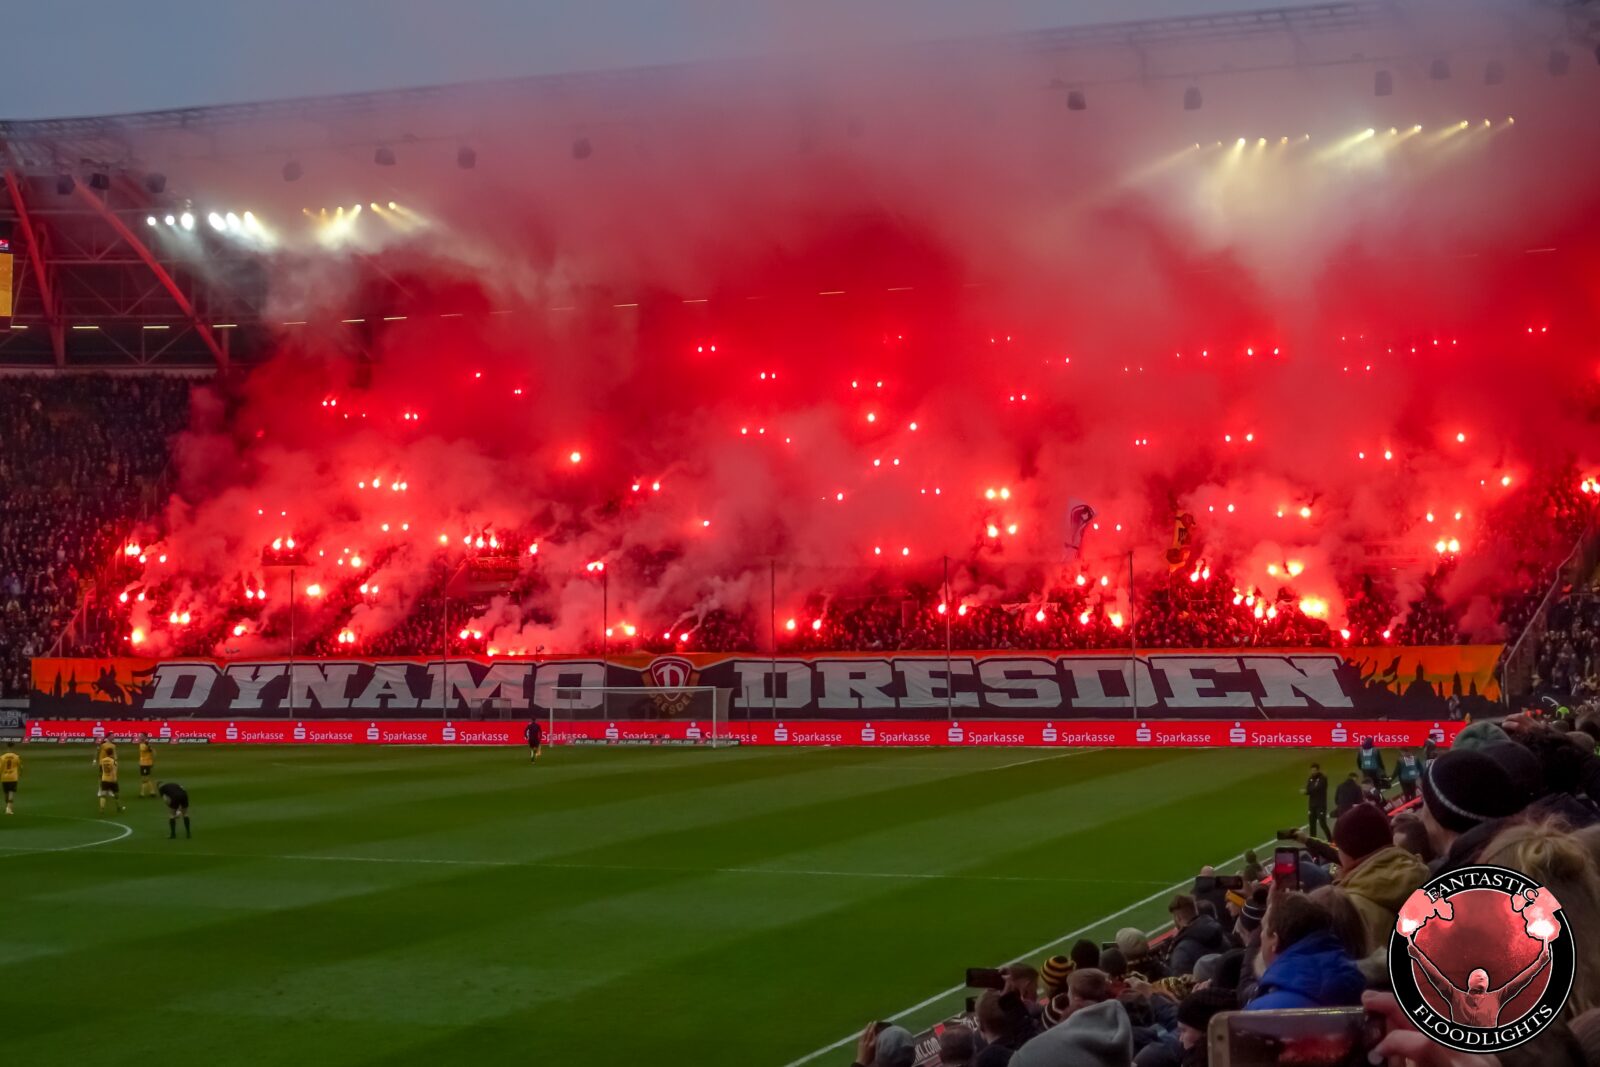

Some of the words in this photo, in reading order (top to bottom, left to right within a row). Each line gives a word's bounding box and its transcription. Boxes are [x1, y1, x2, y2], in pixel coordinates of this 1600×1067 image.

[142, 662, 604, 709] DYNAMO
[733, 656, 1354, 709] DRESDEN
[241, 730, 284, 741] Sparkasse
[309, 730, 353, 742] Sparkasse
[383, 731, 428, 742] Sparkasse
[460, 731, 509, 743] Sparkasse
[792, 731, 842, 743] Sparkasse
[879, 731, 931, 743] Sparkasse
[968, 731, 1025, 744] Sparkasse
[1061, 731, 1116, 743] Sparkasse
[1155, 731, 1212, 744] Sparkasse
[1251, 731, 1312, 744] Sparkasse
[1352, 731, 1410, 745] Sprkasse
